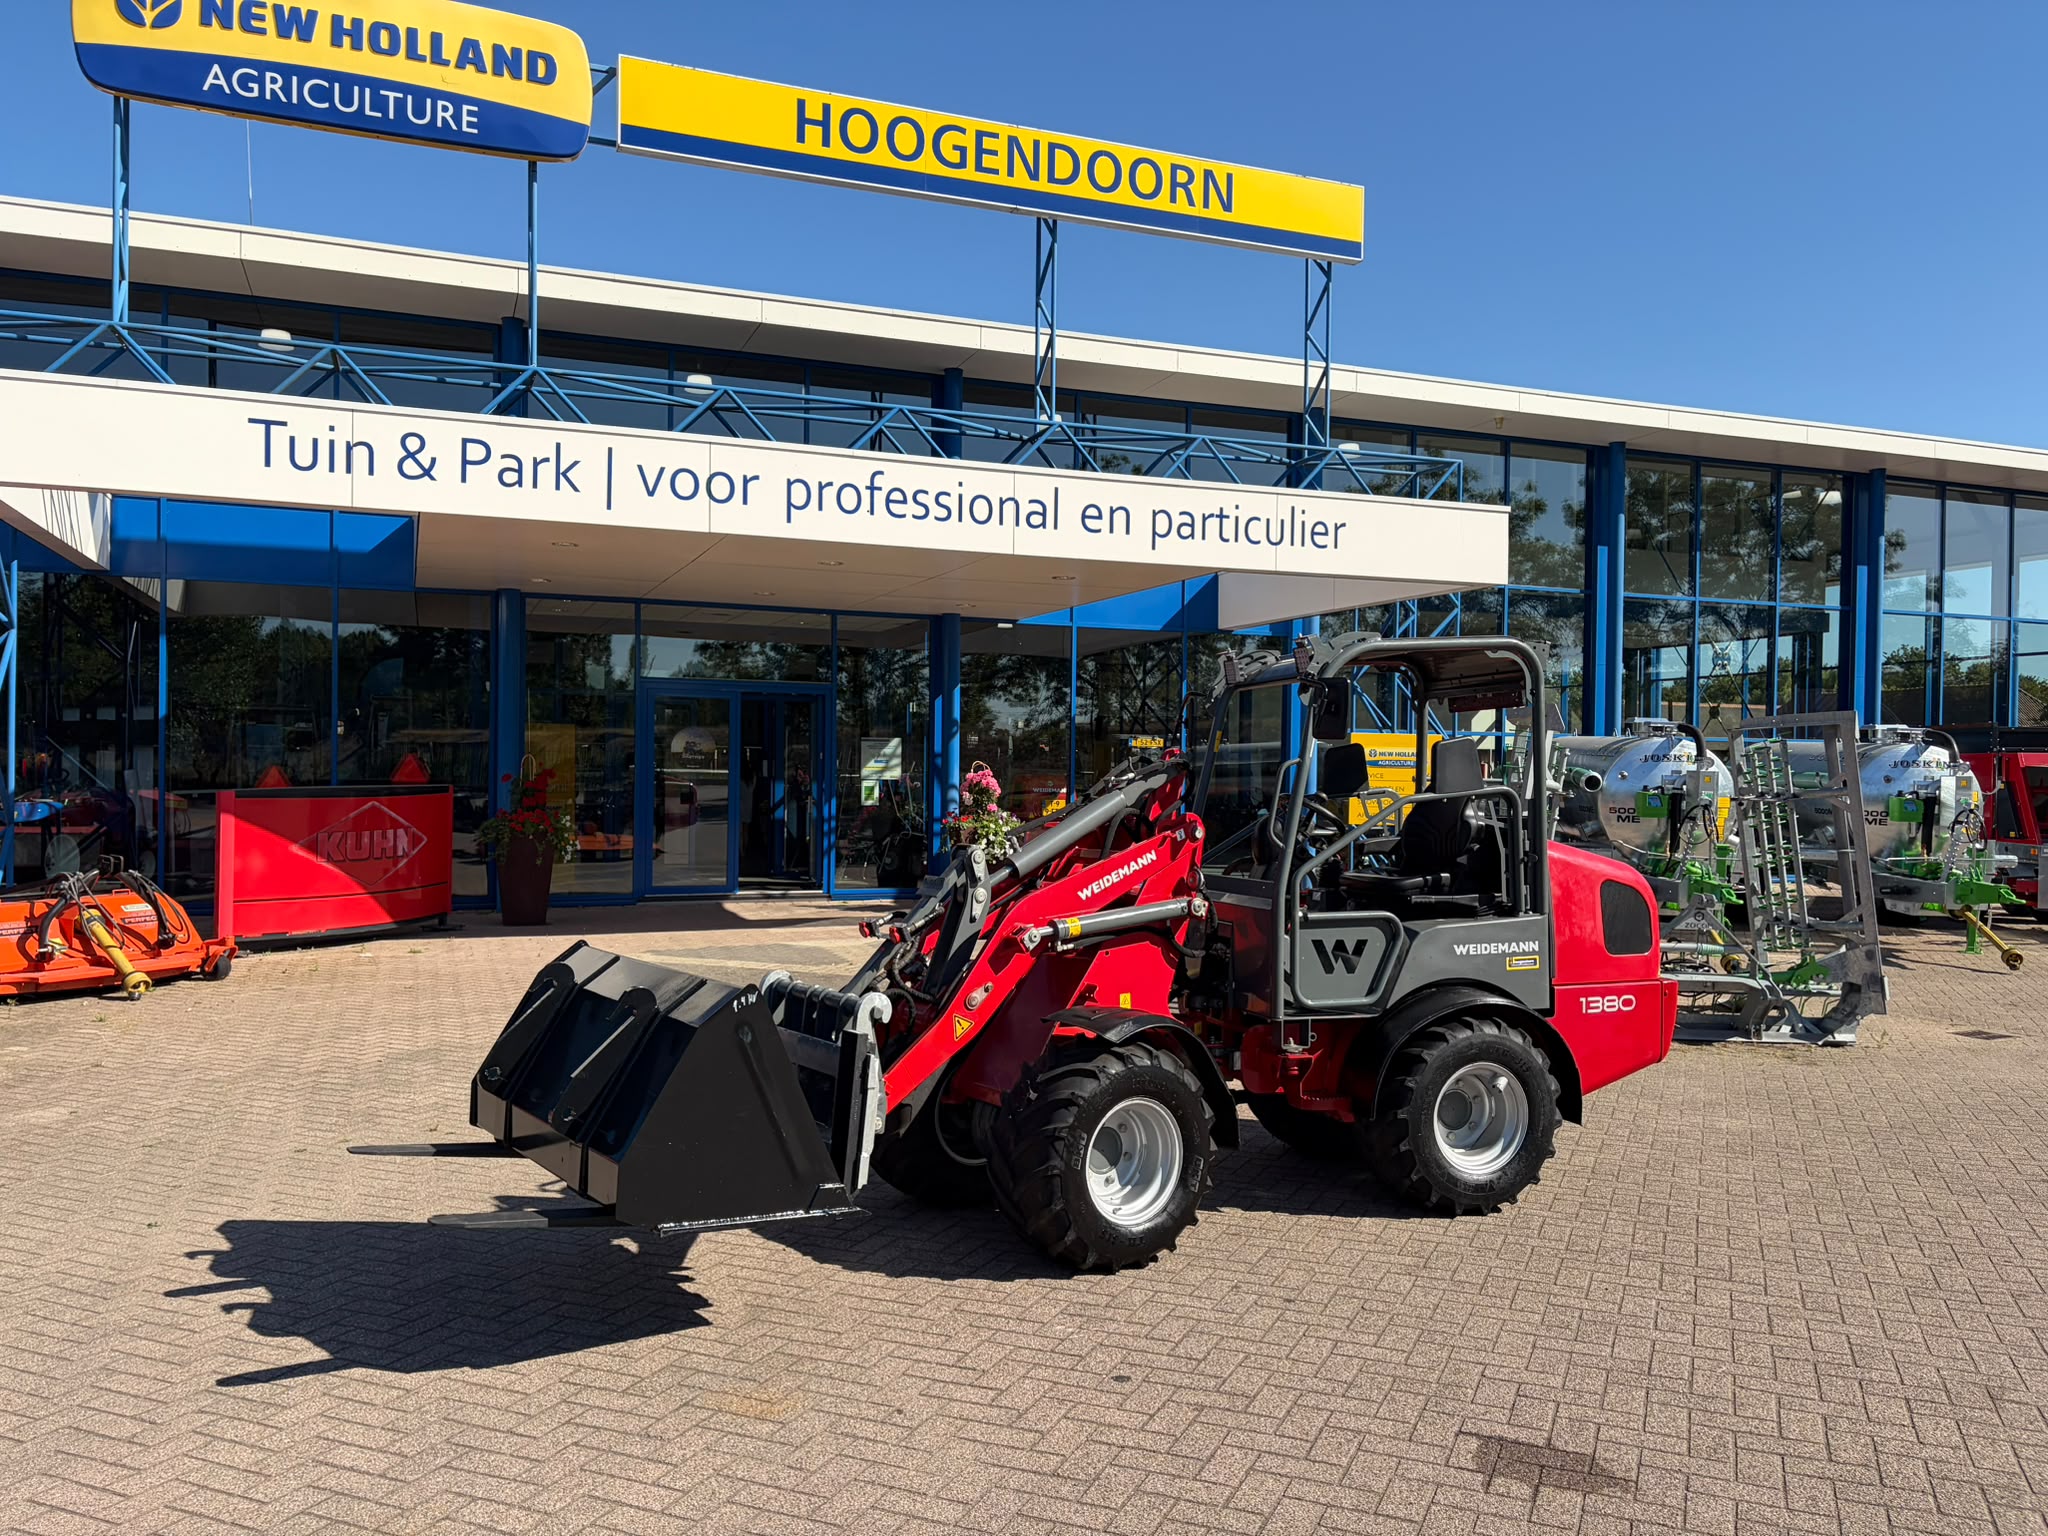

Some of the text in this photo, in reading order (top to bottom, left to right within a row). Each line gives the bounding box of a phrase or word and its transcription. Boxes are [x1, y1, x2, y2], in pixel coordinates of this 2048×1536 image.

[200, 0, 558, 85] NEW HOLLAND
[202, 63, 479, 134] AGRICULTURE
[796, 98, 1234, 213] HOOGENDOORN
[247, 417, 375, 477] Tuin
[396, 431, 437, 482] &
[460, 437, 581, 493] Park
[636, 464, 760, 506] voor
[786, 470, 1060, 530] professional
[1080, 503, 1131, 536] en
[1151, 504, 1347, 551] particulier
[1640, 753, 1698, 764] JOSKI
[1609, 806, 1636, 815] 500
[1616, 814, 1641, 824] ME
[316, 827, 415, 862] KUHN
[1077, 849, 1158, 901] WEIDEMANN
[1453, 940, 1540, 956] WEIDEMANN
[1579, 994, 1637, 1015] 1380
